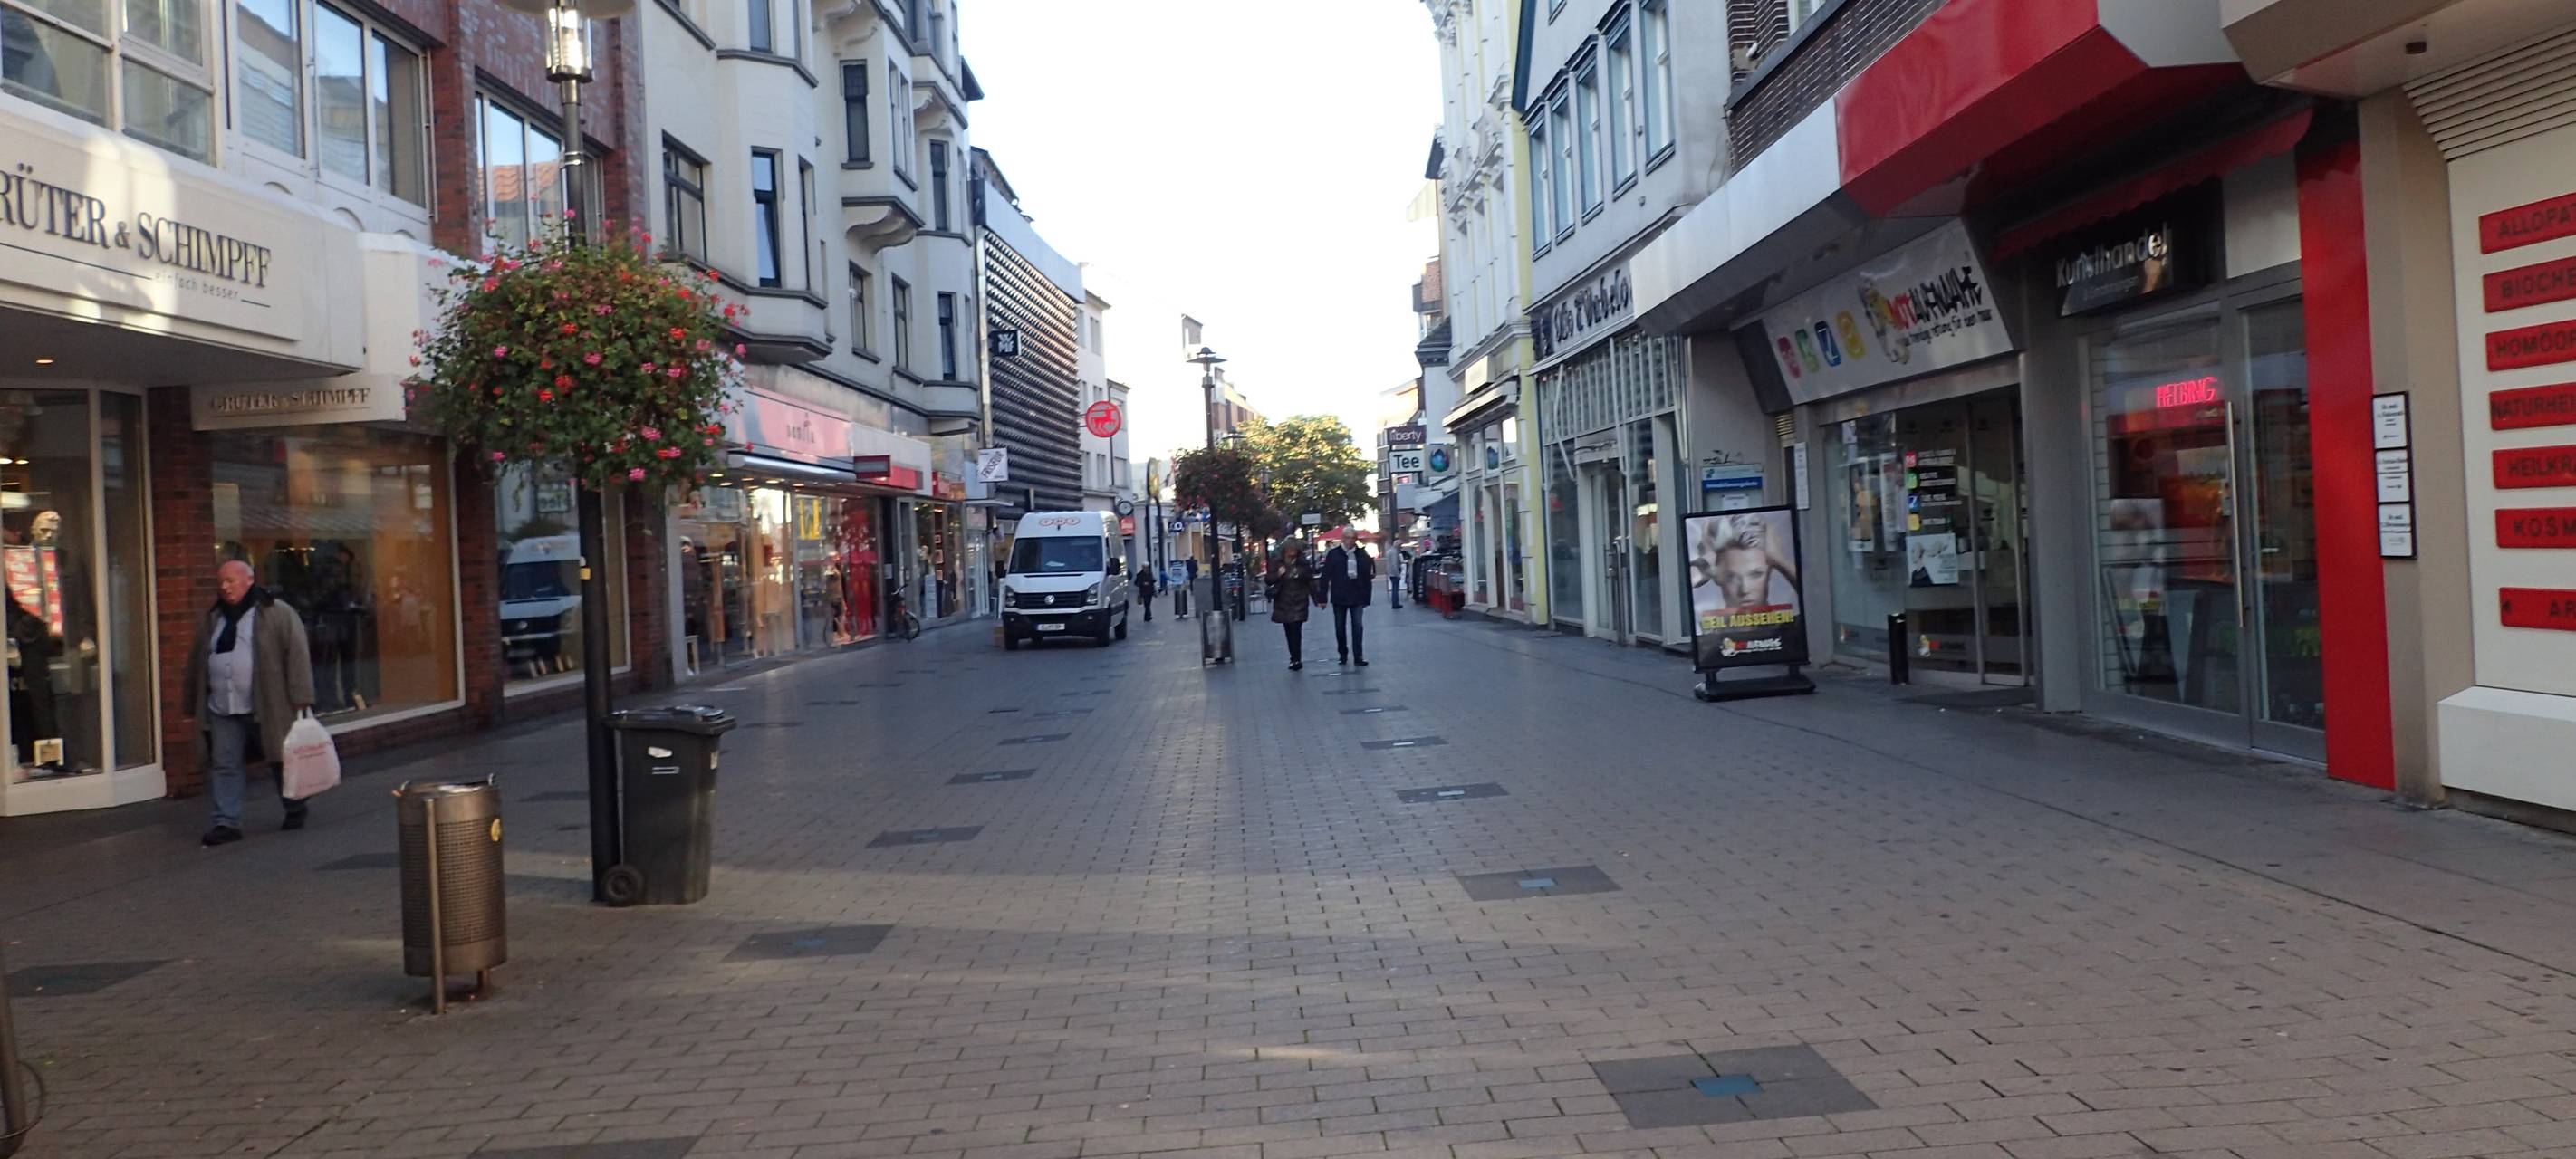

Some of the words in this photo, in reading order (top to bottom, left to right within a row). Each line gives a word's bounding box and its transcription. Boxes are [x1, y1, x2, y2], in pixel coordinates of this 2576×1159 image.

[115, 221, 131, 250] &
[138, 211, 271, 288] SCHIMPFF
[2056, 221, 2167, 289] Kunsthandel
[202, 283, 239, 300] besser
[2501, 266, 2576, 300] BIOCHE
[1389, 428, 1423, 443] liberty
[1393, 454, 1420, 469] Tee
[2507, 455, 2576, 478] HEILKR
[2514, 515, 2576, 538] KOSM
